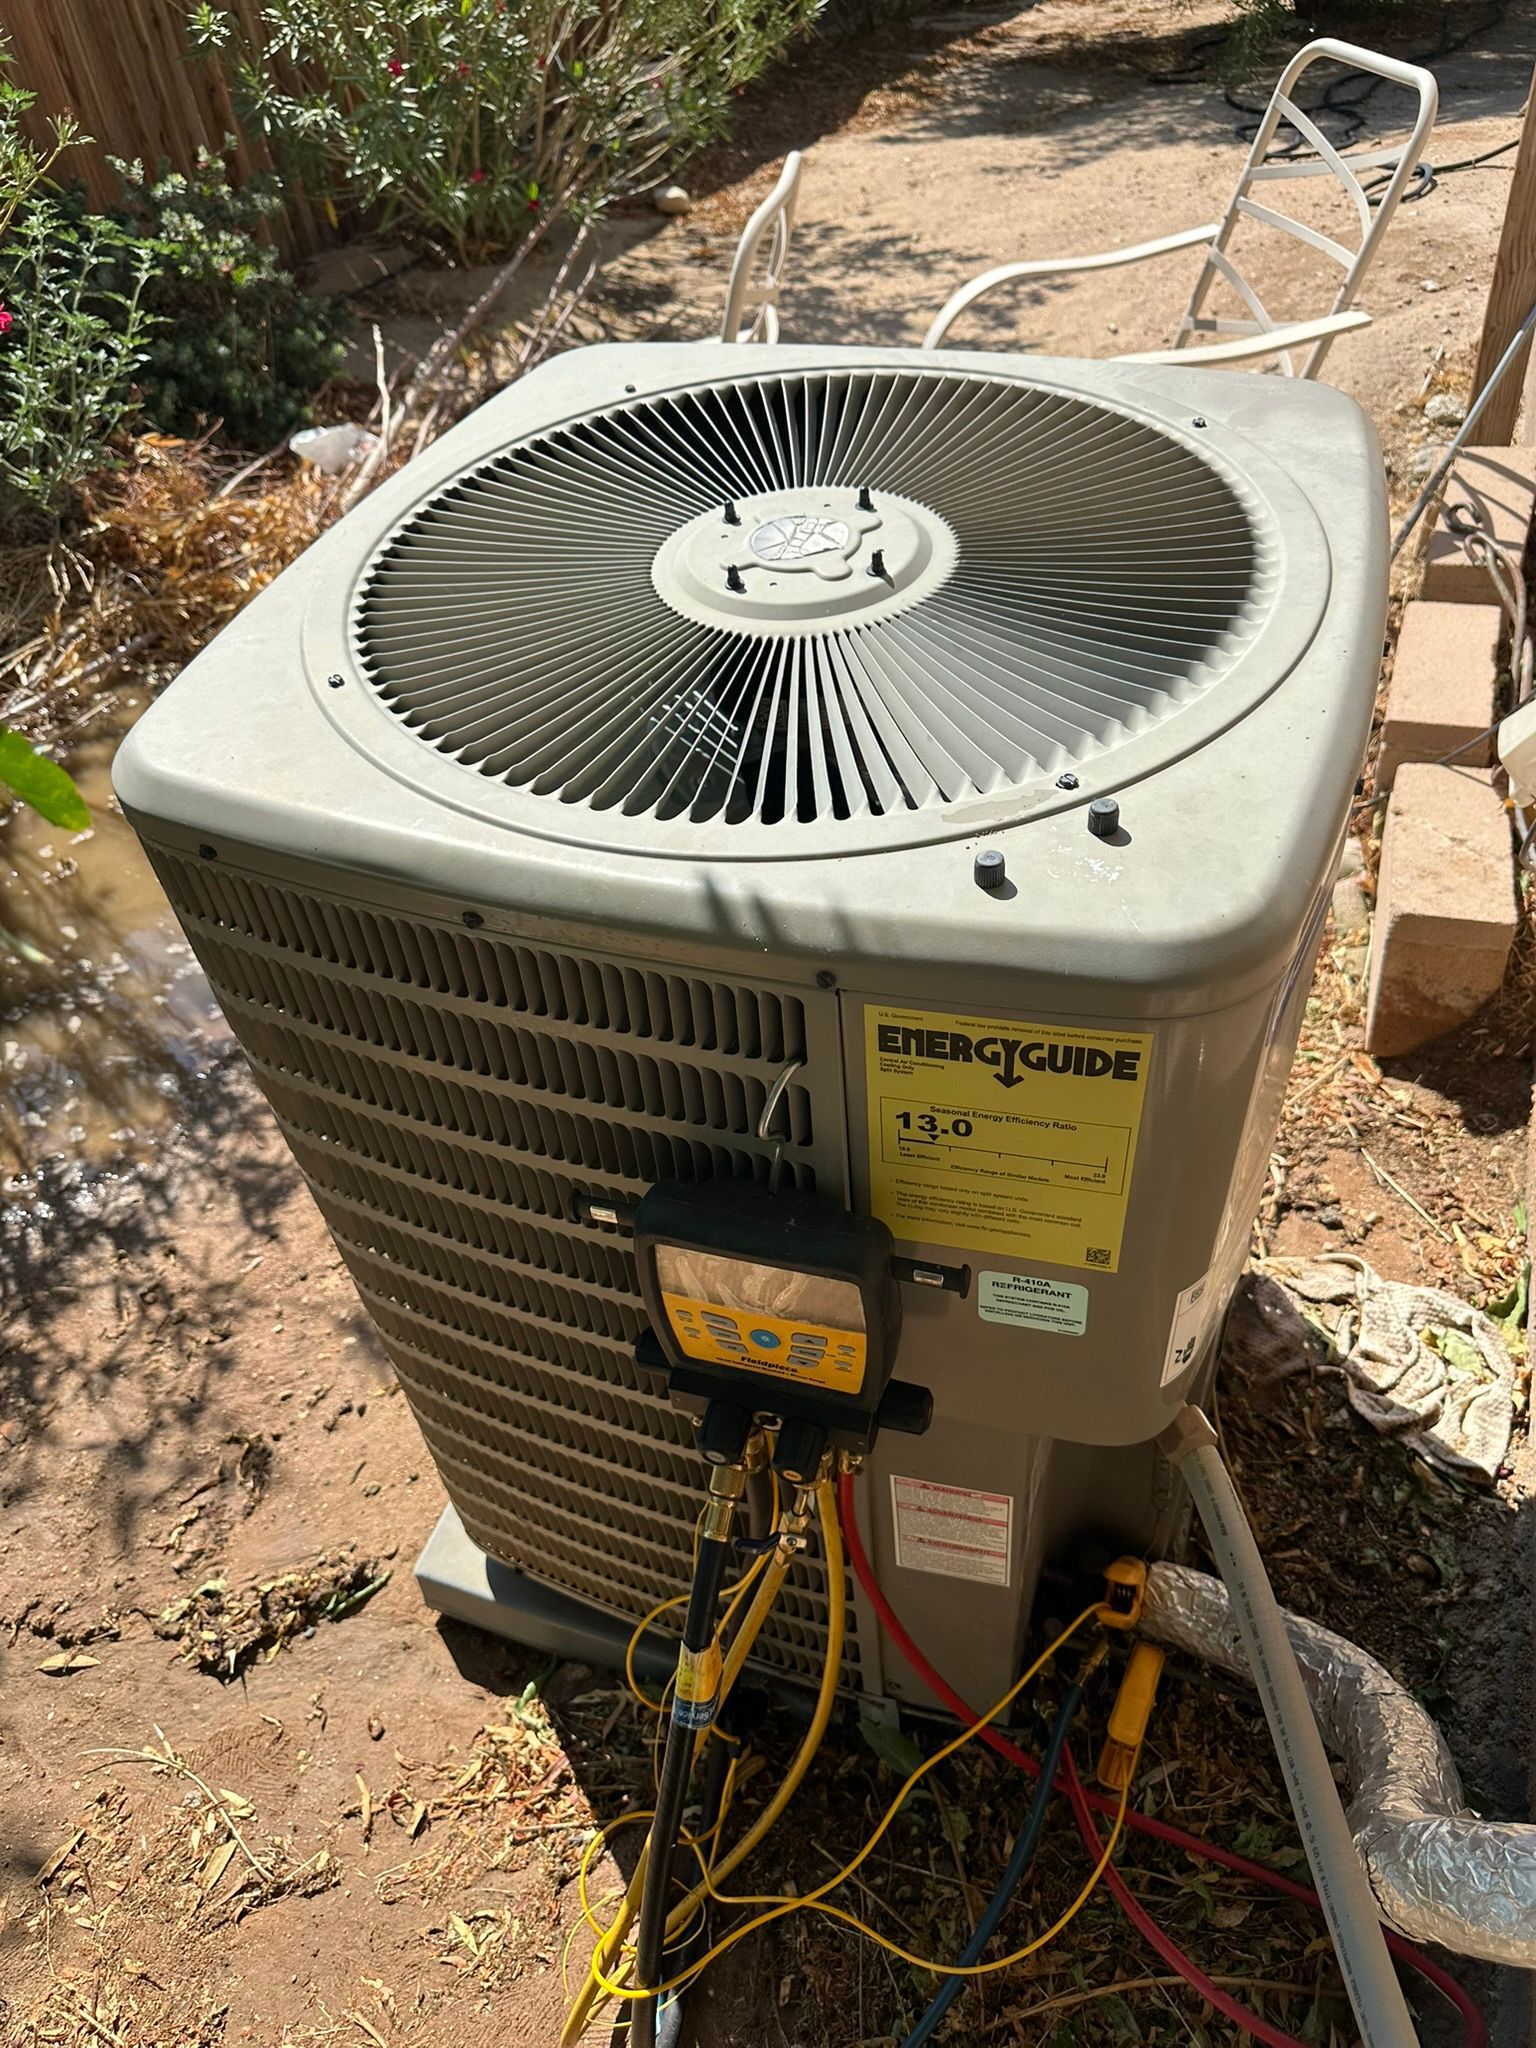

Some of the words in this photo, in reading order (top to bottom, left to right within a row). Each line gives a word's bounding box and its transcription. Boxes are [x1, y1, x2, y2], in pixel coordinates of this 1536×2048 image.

[891, 1012, 923, 1021] Government
[956, 1020, 976, 1028] Federal
[880, 1062, 900, 1070] Cooling
[909, 1060, 944, 1070] Conditioning
[930, 1105, 969, 1117] Seasonal
[972, 1111, 1003, 1122] Energy
[1006, 1115, 1050, 1128] Efficiency
[1052, 1122, 1077, 1131] Ratio
[896, 1111, 973, 1137] 13.0
[916, 1153, 940, 1161] Efficient
[951, 1164, 978, 1173] Efficiency
[980, 1168, 998, 1176] Range
[1080, 1176, 1106, 1184] Efficient
[1019, 1209, 1055, 1218] Government
[1012, 1276, 1051, 1288] R-410A
[992, 1281, 1072, 1299] REFRIGERANT
[741, 1356, 798, 1373] Fieldpiece
